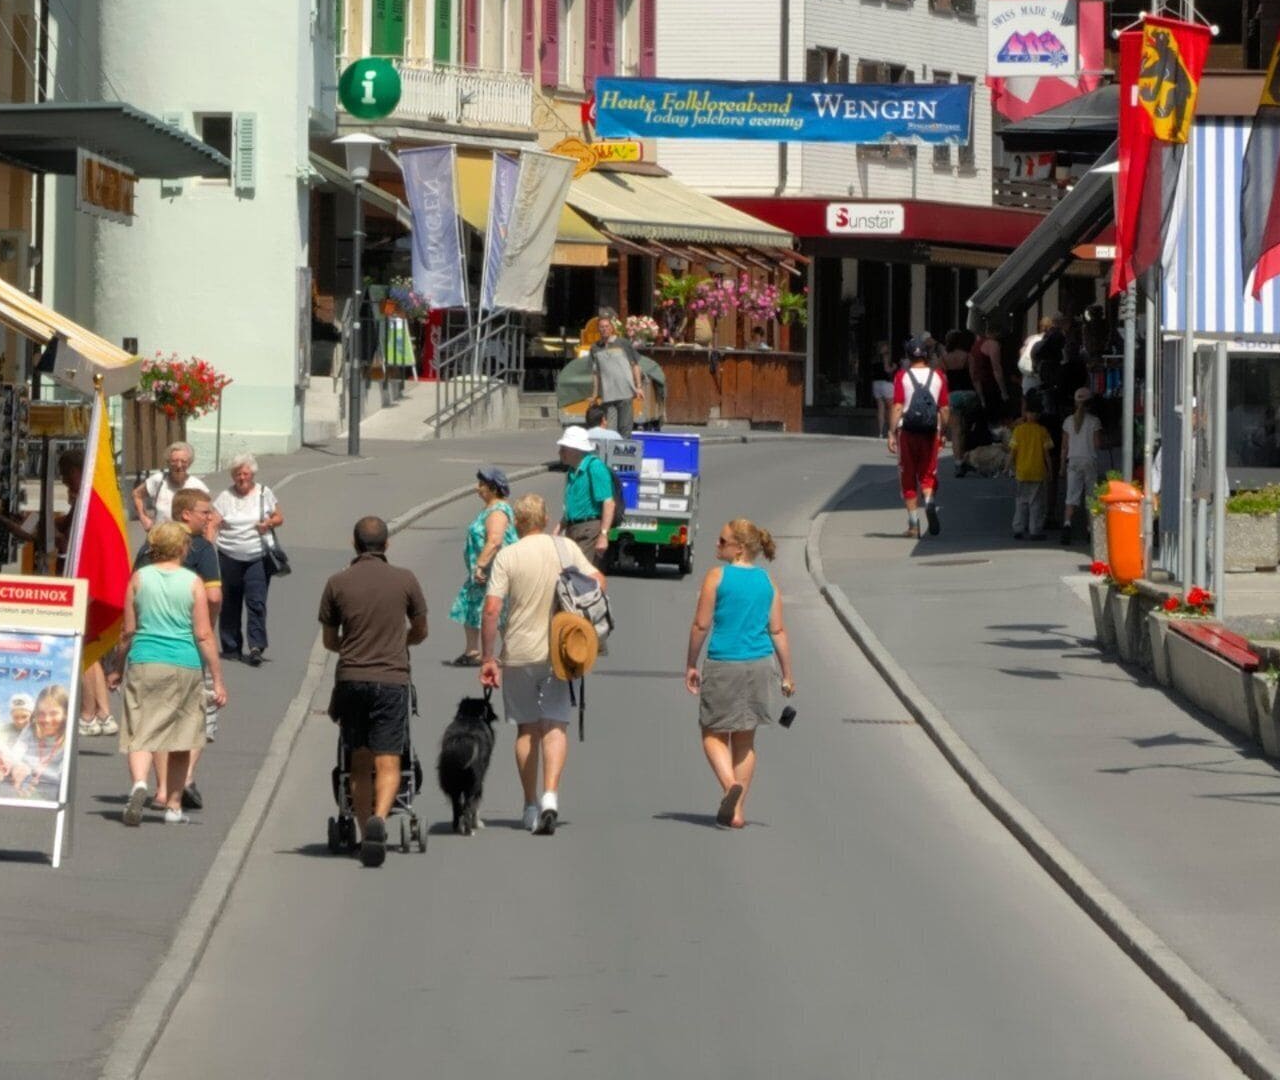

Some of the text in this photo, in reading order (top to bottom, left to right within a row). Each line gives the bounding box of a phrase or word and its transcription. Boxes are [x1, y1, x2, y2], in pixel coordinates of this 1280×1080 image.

[1020, 6, 1047, 16] MADE
[600, 91, 656, 111] Heute
[645, 110, 689, 127] Today
[749, 117, 804, 130] evening
[835, 207, 895, 230] Sunstar
